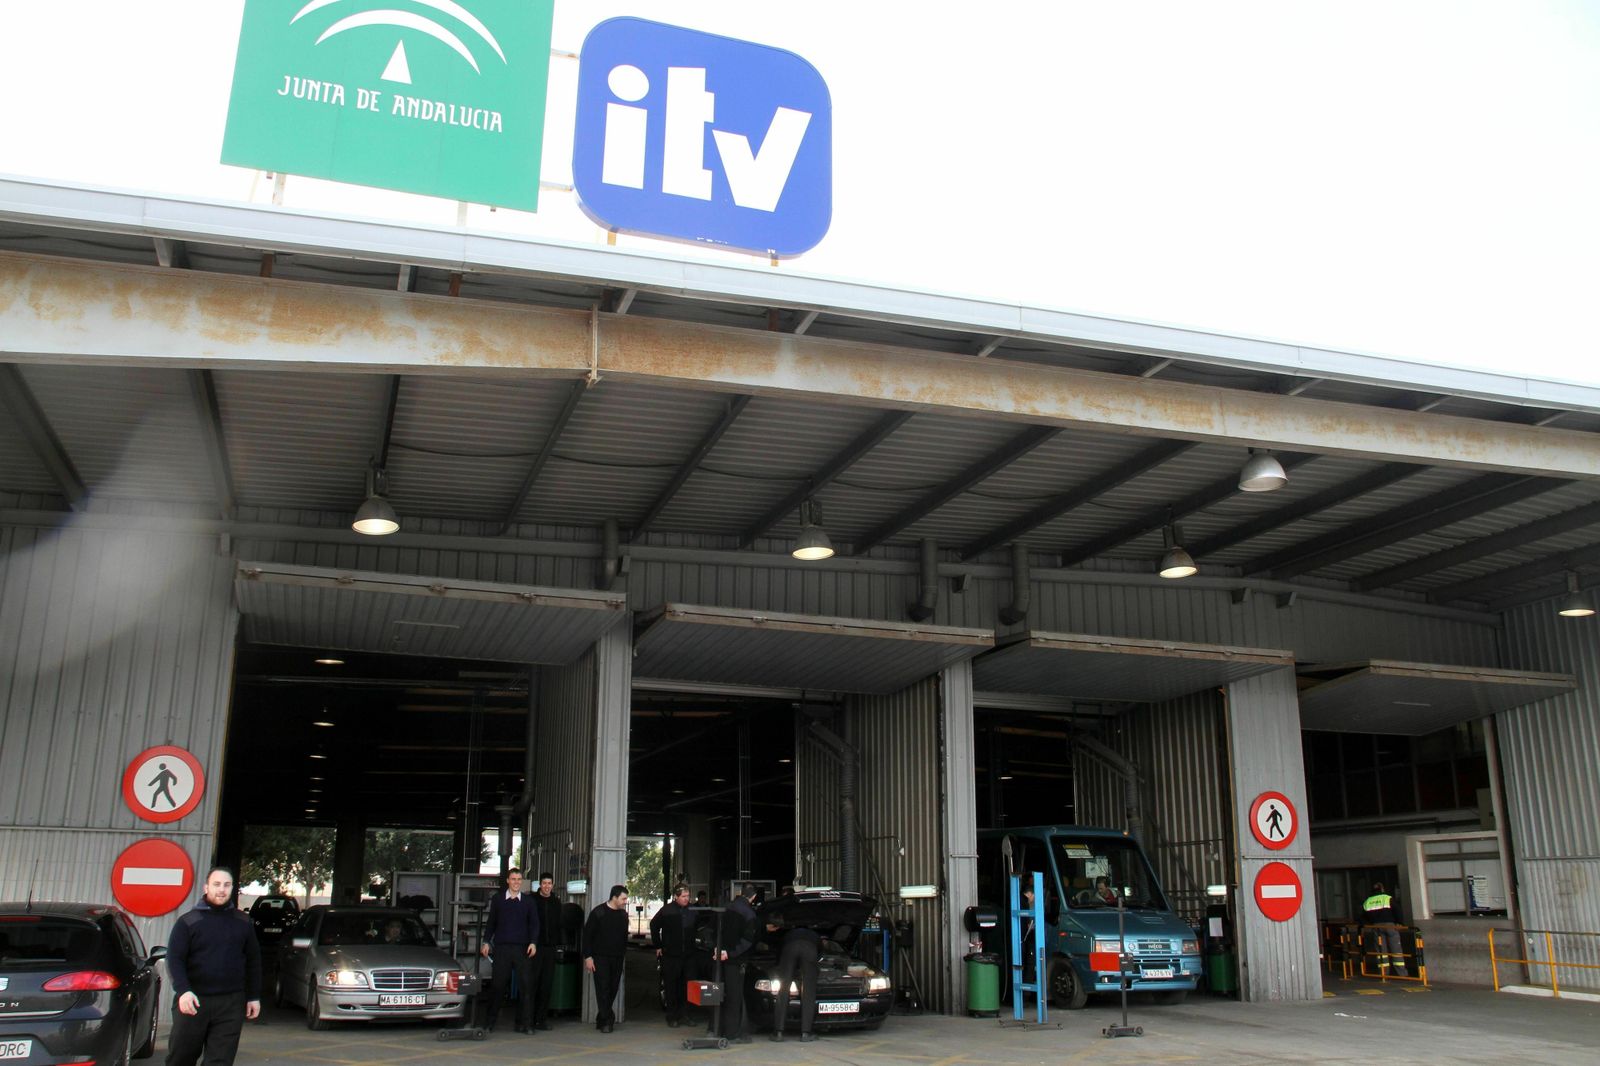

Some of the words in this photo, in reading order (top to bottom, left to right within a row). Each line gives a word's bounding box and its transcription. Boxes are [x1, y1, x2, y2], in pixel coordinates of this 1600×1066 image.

[277, 75, 345, 106] JUNTA
[356, 88, 382, 112] DE
[392, 94, 503, 133] ANDALUCIA
[601, 64, 813, 213] itv
